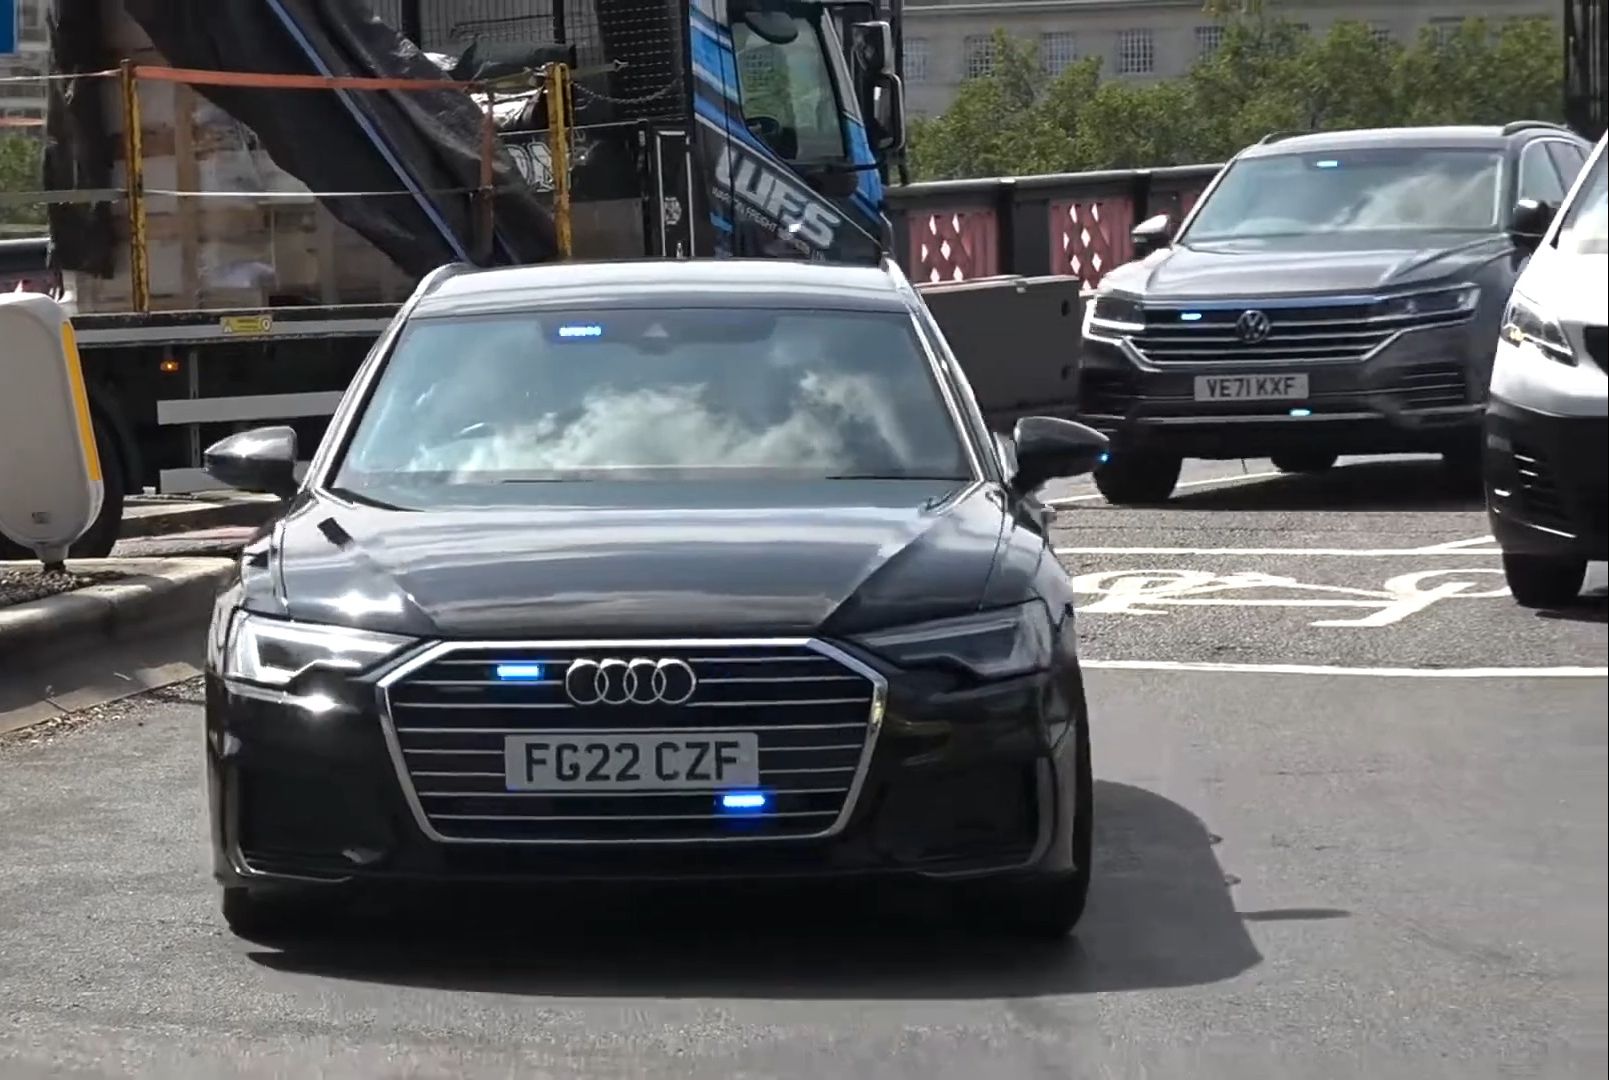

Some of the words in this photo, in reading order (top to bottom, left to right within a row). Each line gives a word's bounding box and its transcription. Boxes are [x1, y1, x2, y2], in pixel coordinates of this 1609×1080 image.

[1207, 378, 1251, 398] VE71
[1256, 377, 1296, 396] KXF
[525, 743, 640, 782] FG22
[655, 741, 739, 781] CZF
